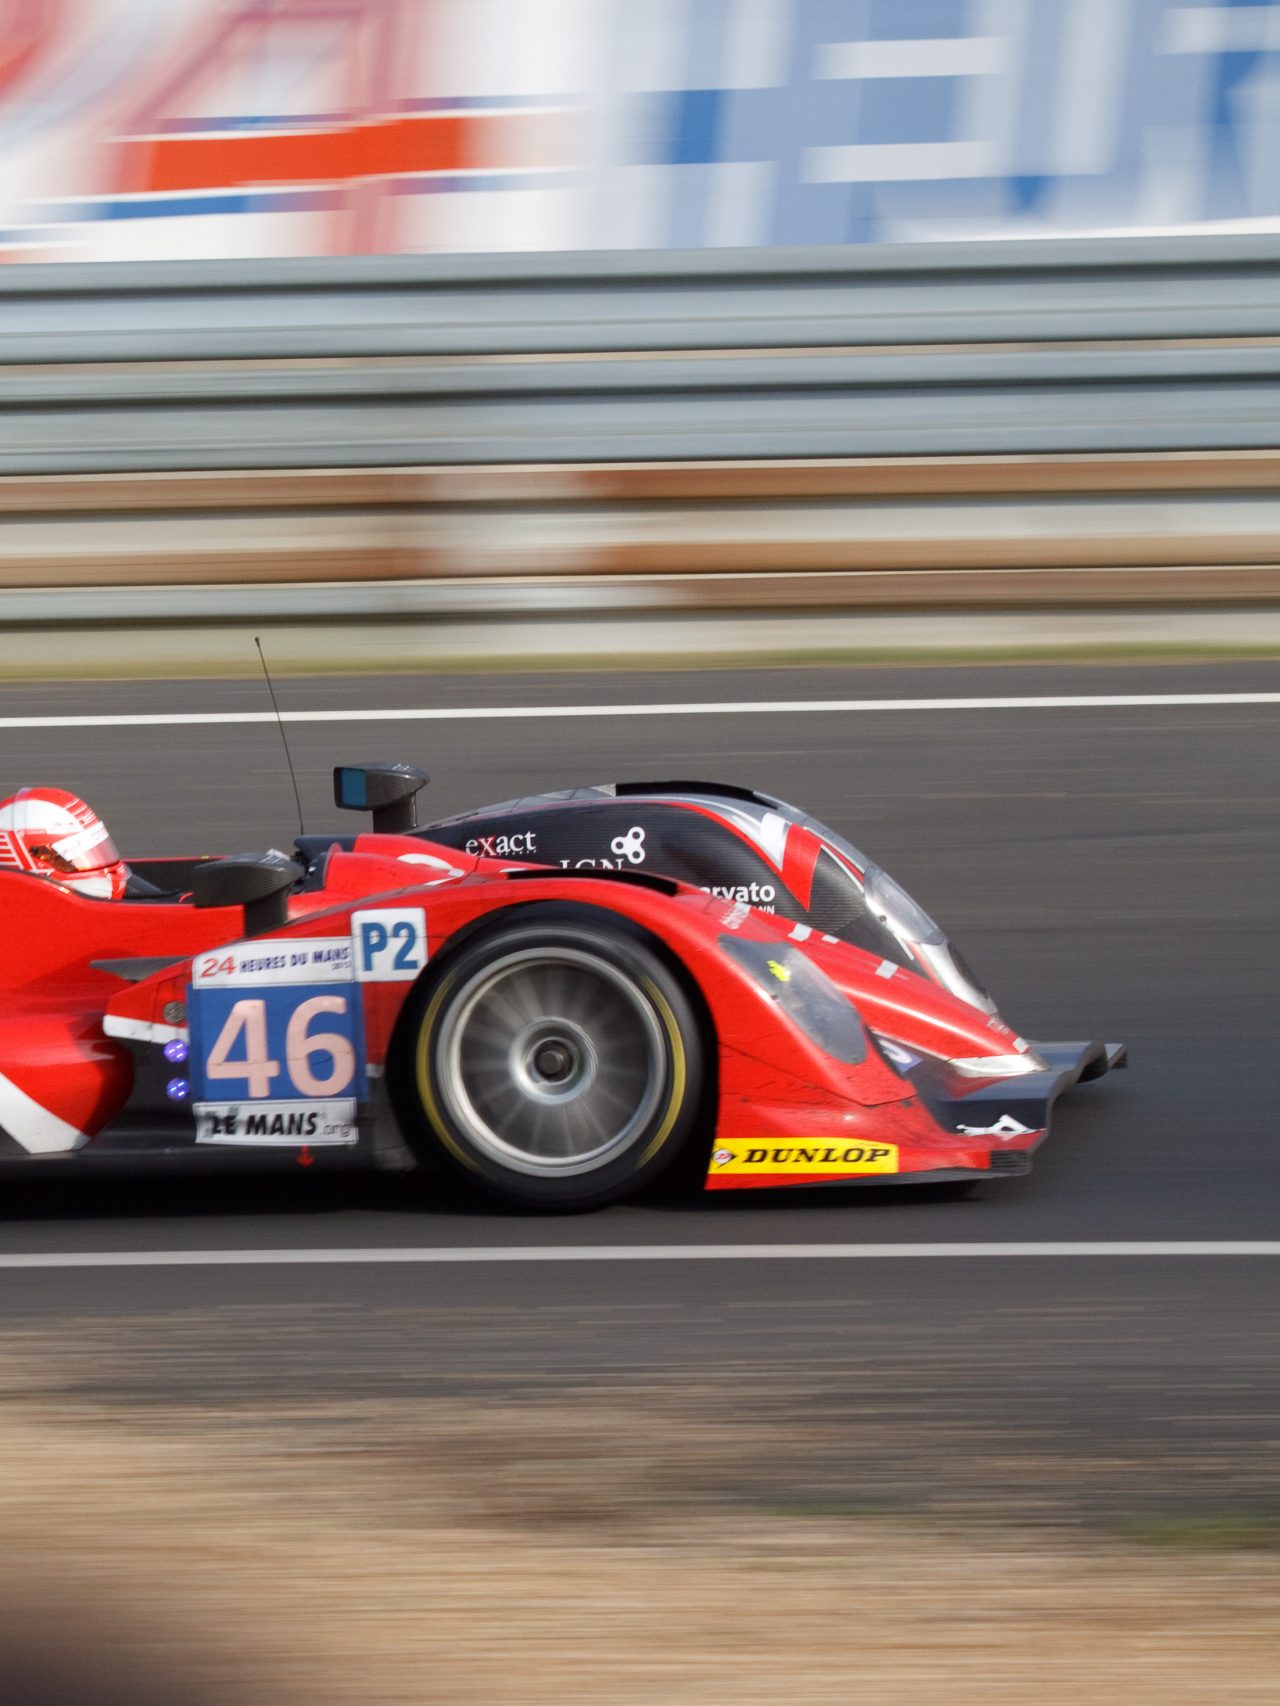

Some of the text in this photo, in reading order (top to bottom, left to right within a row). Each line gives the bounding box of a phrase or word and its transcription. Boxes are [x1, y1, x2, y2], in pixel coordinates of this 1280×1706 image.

[466, 831, 536, 858] exact
[361, 921, 419, 971] P2
[200, 947, 349, 978] 24 HEURES DU MANS
[206, 996, 356, 1098] 46
[245, 1111, 318, 1136] MANS
[742, 1147, 891, 1164] DUNLOP
